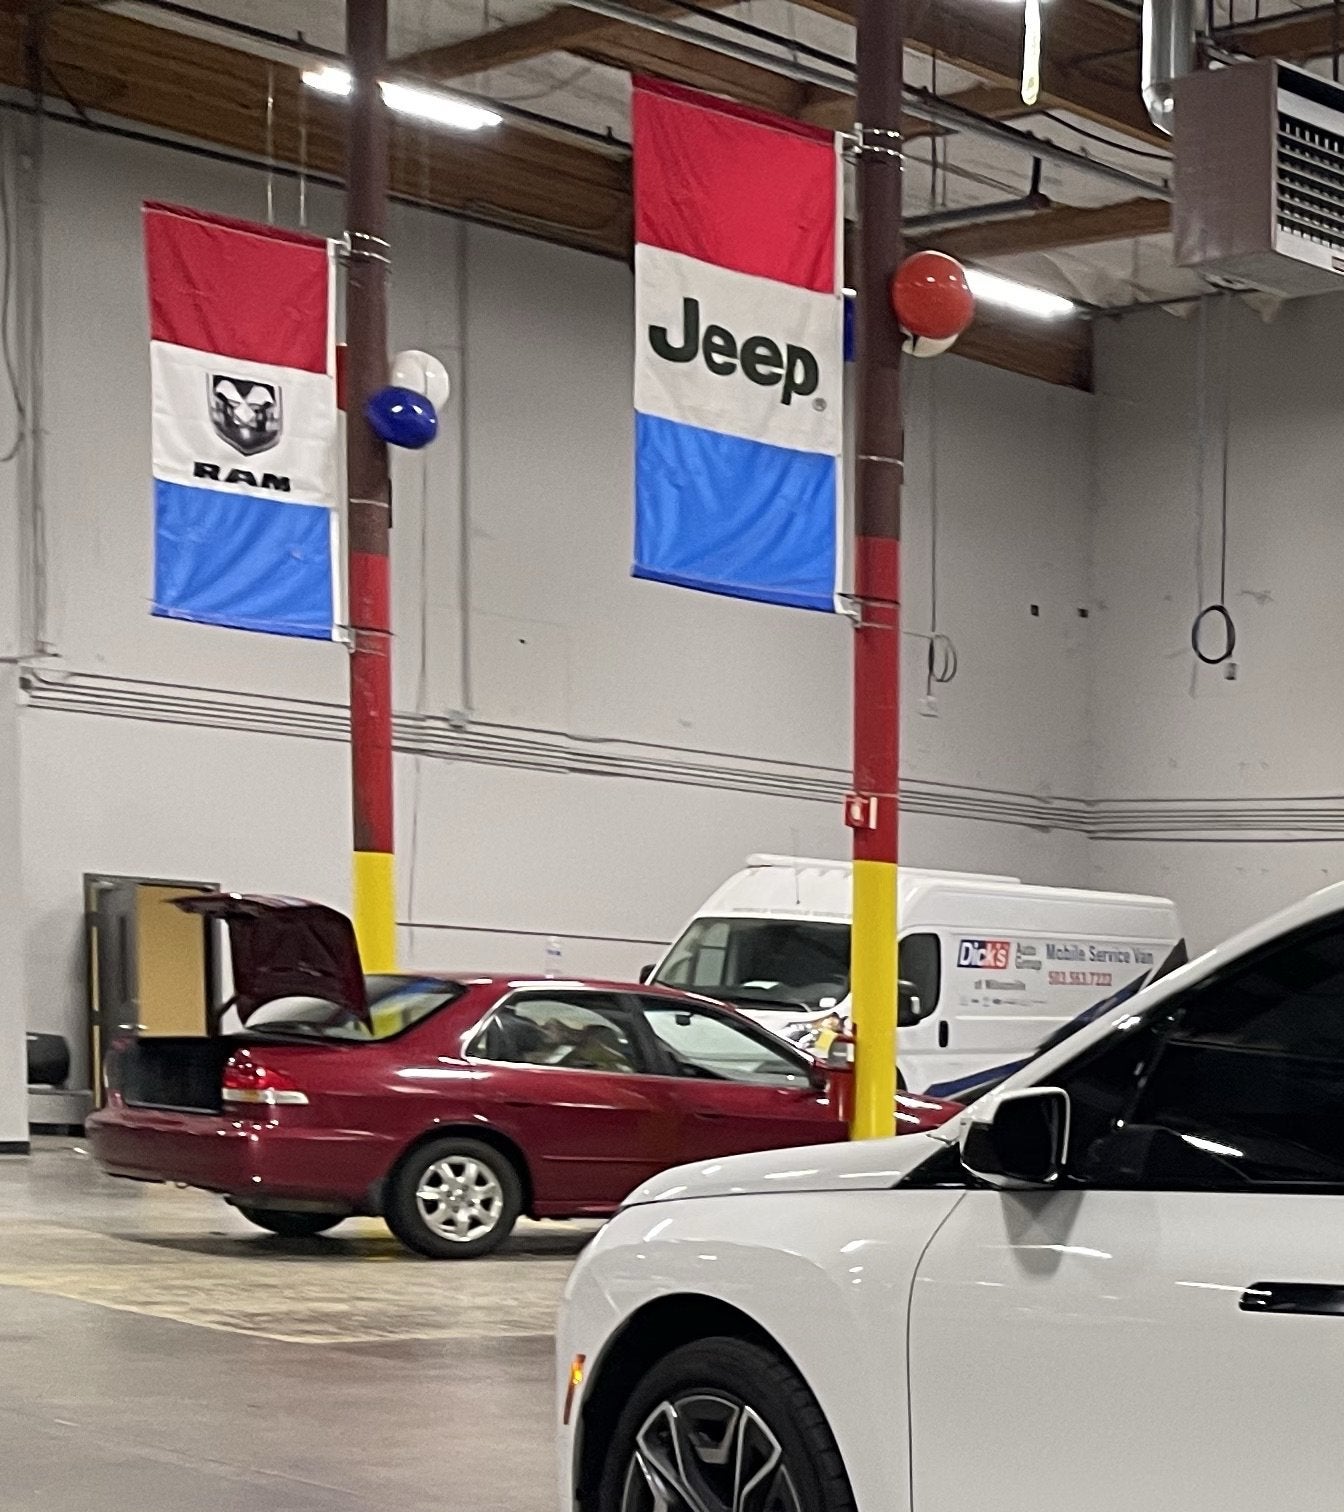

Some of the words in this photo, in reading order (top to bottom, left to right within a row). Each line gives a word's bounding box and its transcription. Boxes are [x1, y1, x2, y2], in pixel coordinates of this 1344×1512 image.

[648, 297, 819, 406] Jeep
[193, 461, 291, 492] RAM
[959, 941, 1008, 968] Dick's
[1046, 943, 1086, 961] Mobile
[1089, 945, 1131, 963] Service
